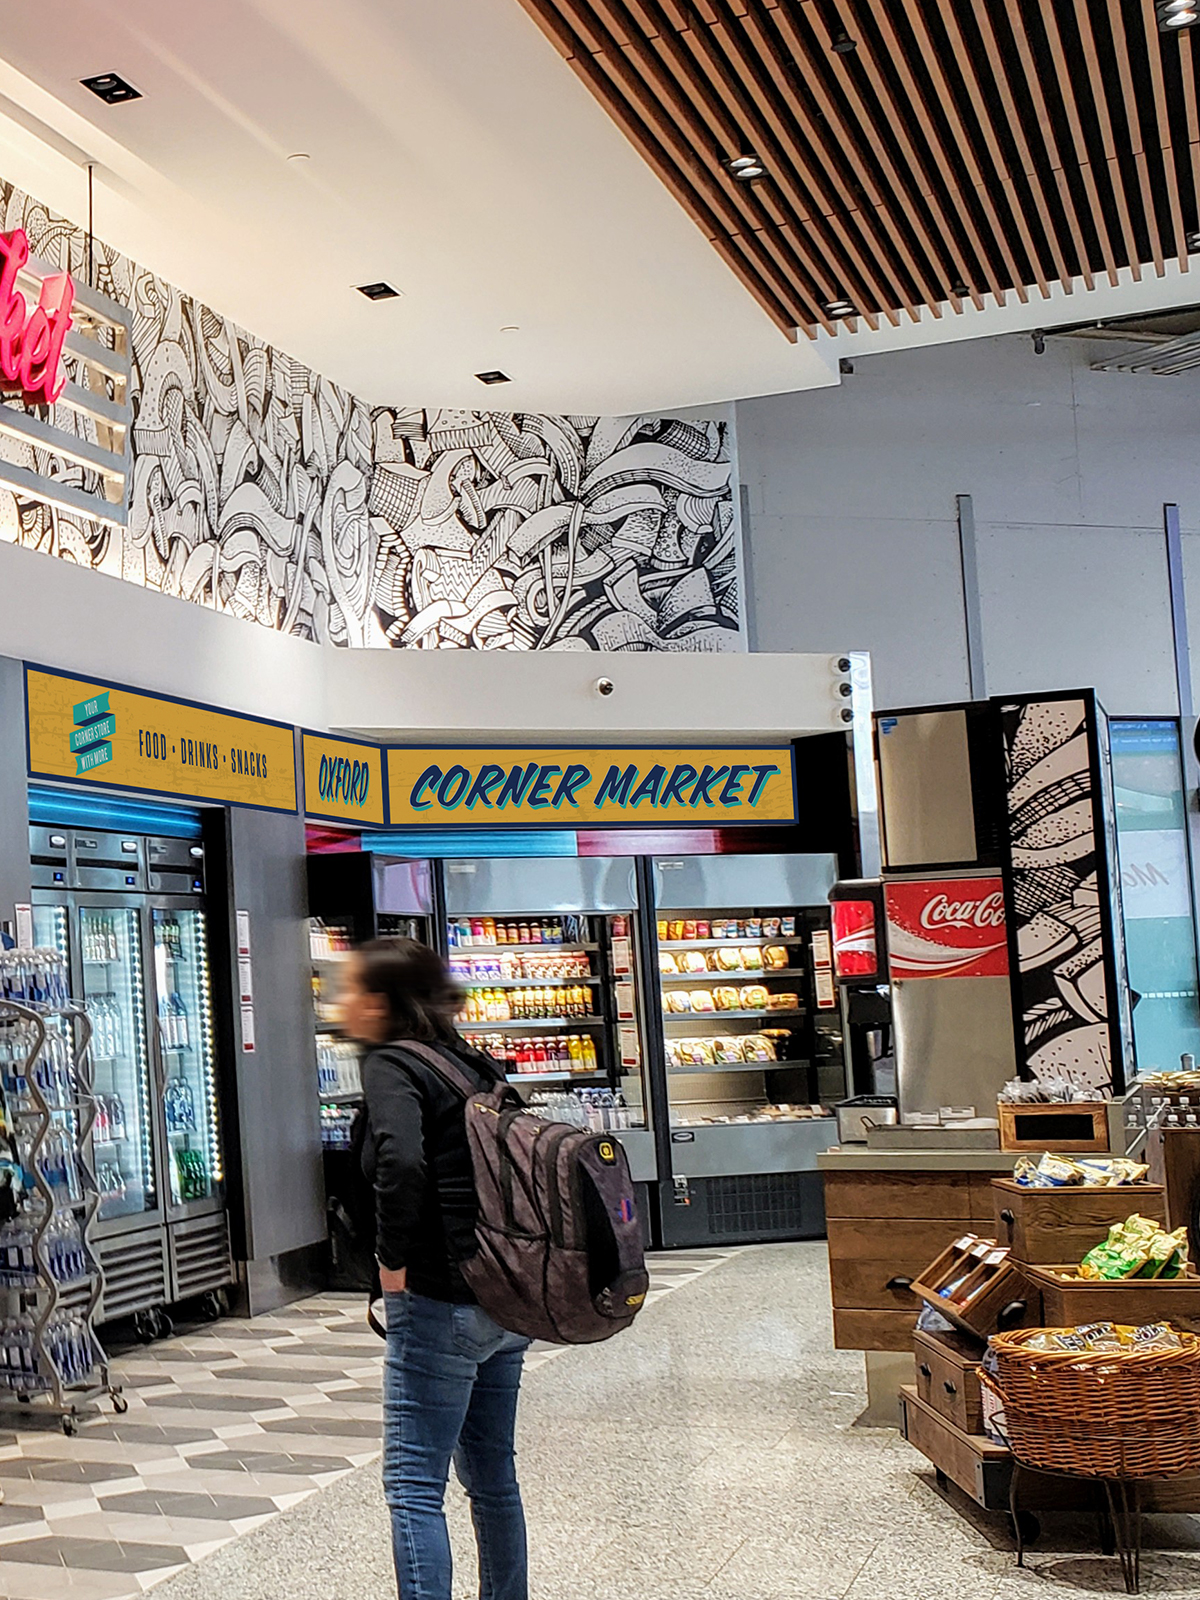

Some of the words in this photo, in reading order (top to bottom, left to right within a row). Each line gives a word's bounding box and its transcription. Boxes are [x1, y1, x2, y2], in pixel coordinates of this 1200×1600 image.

[84, 700, 99, 717] YOUR
[94, 747, 109, 766] MORE
[138, 729, 167, 761] FOOD
[181, 738, 219, 770] DRINKS
[231, 748, 268, 779] SNACKS
[318, 753, 369, 807] OXFORD
[409, 762, 592, 811] CORNER
[593, 763, 781, 809] MARKET
